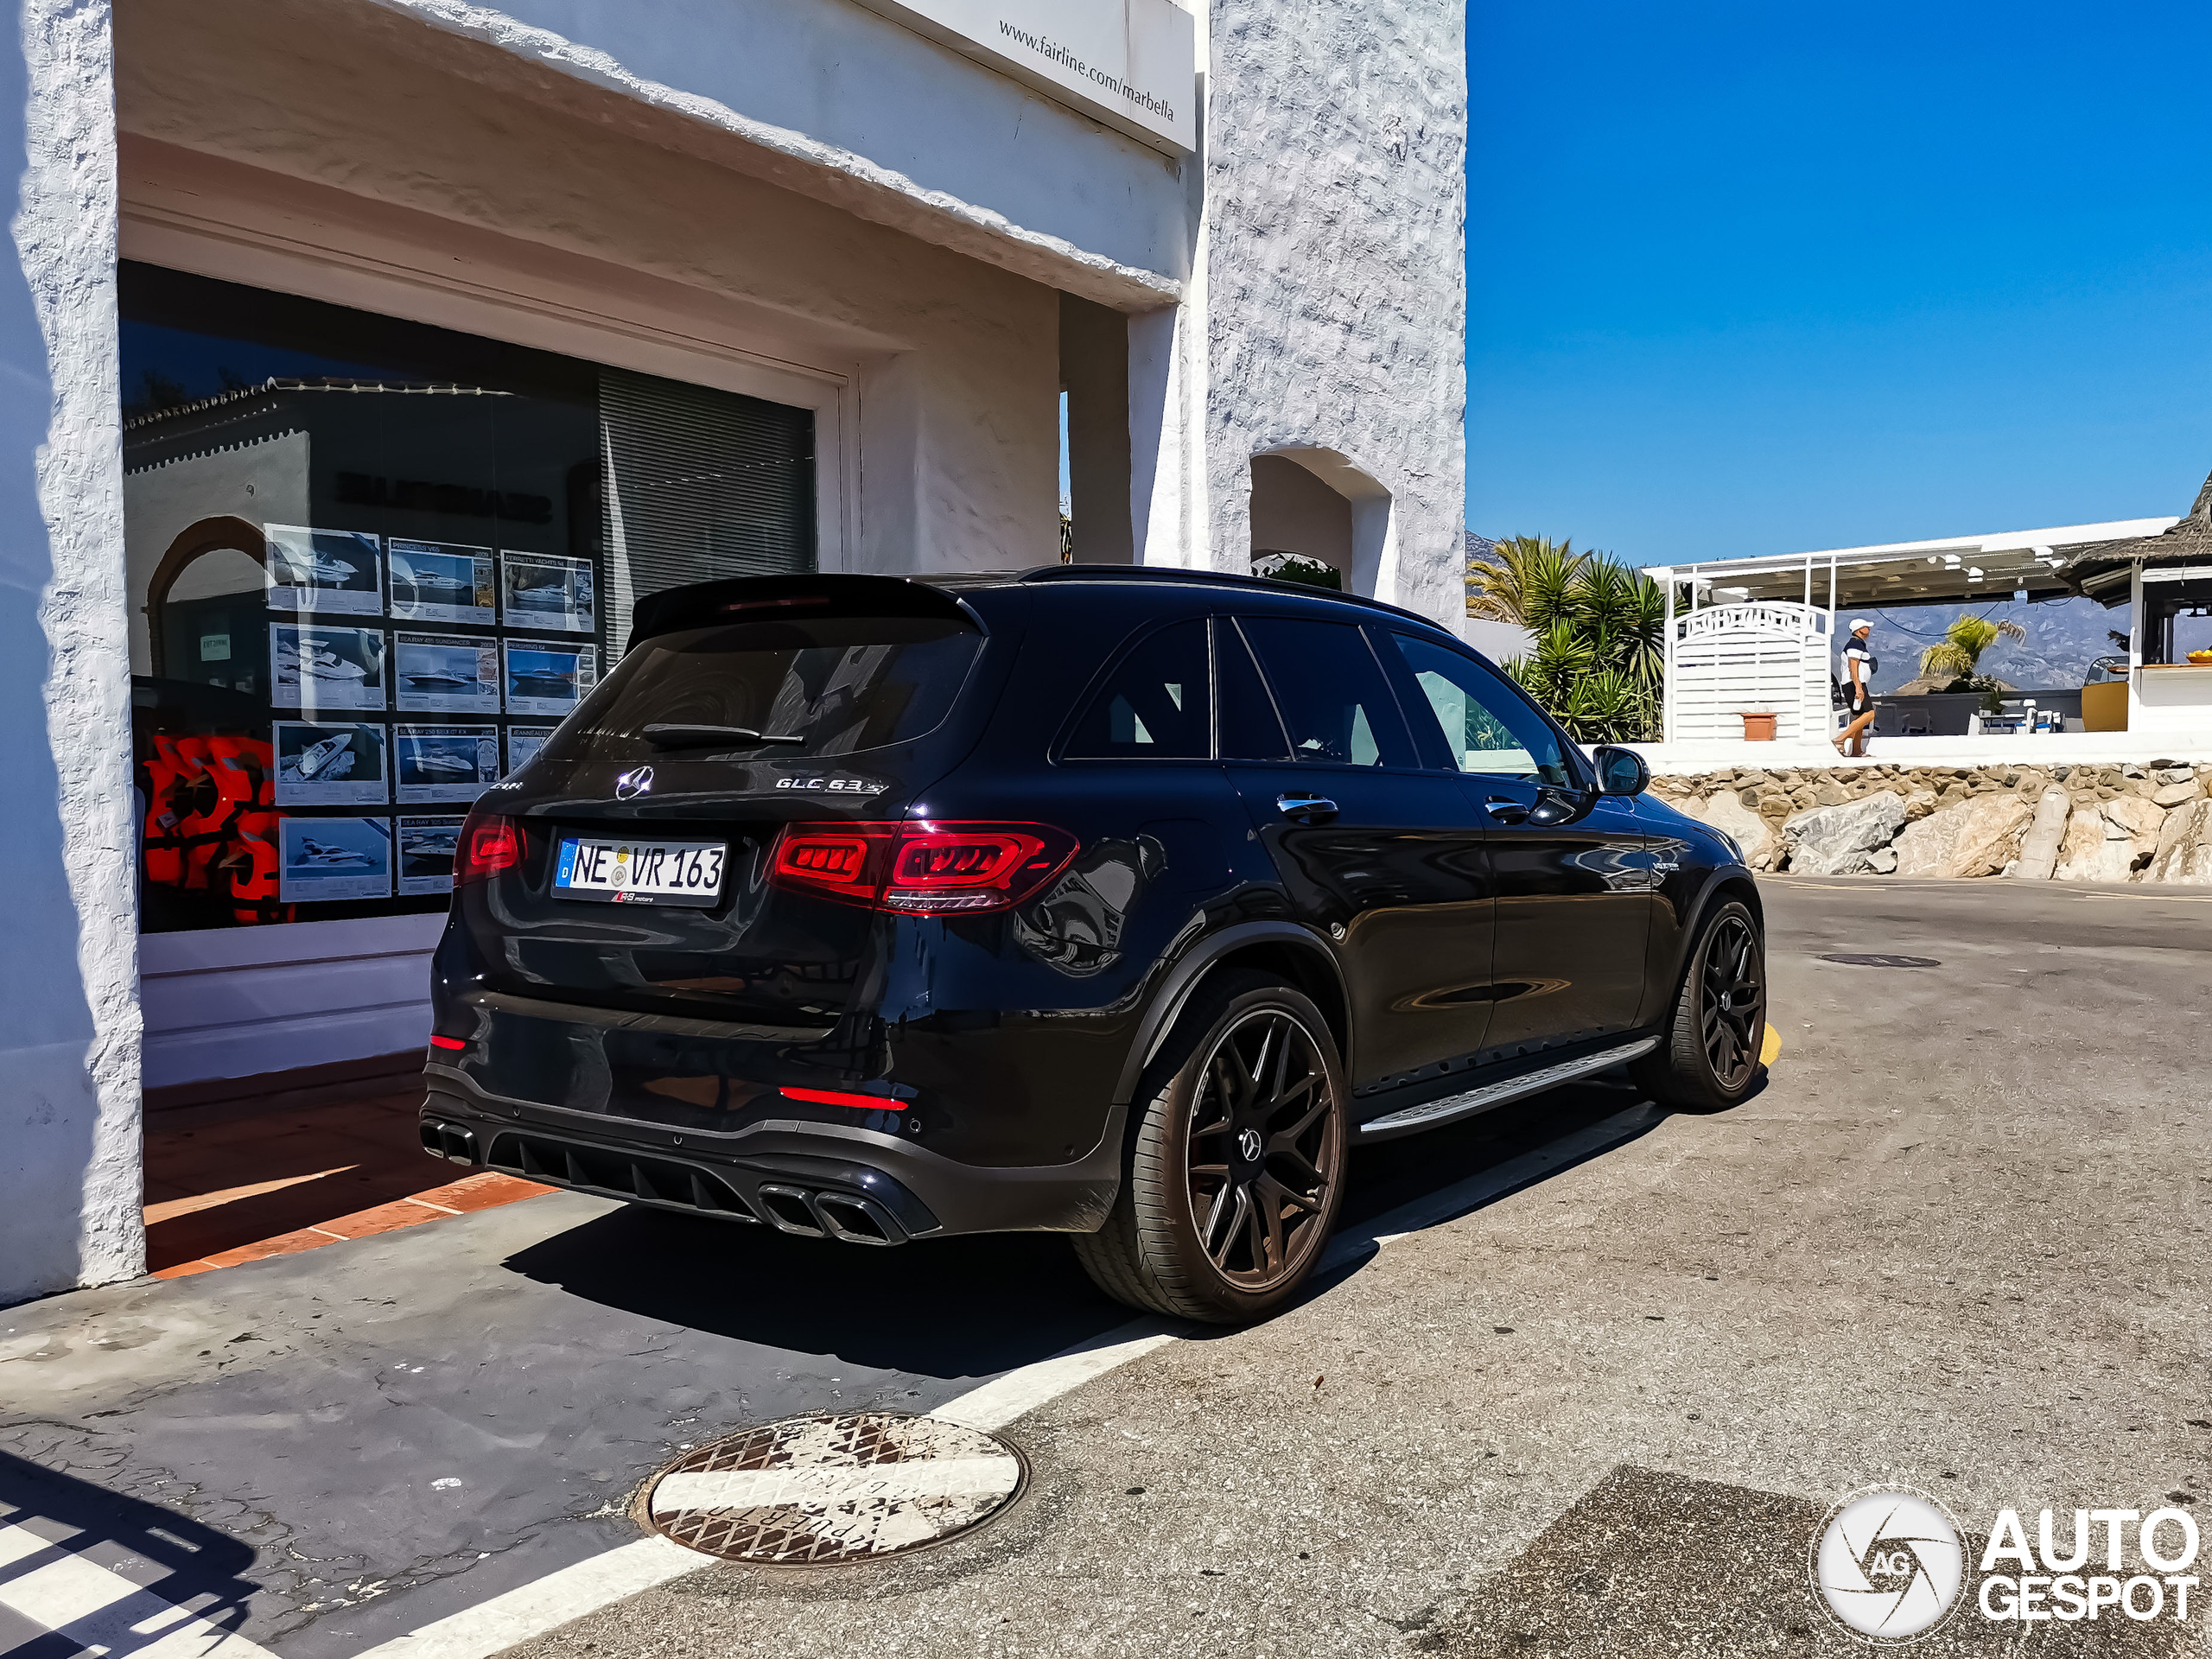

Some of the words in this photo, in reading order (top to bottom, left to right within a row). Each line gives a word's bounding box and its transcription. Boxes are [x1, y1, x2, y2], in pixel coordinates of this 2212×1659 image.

[999, 20, 1174, 123] www.fairline.com/marbella
[392, 542, 426, 551] PRINCESS
[505, 555, 534, 563] FERRETTI
[435, 638, 471, 646] SUNDANCER
[775, 778, 825, 790] GLC
[828, 779, 863, 791] 63
[573, 844, 613, 883] NE
[632, 846, 666, 887] VR
[669, 848, 723, 889] 163
[561, 867, 569, 879] D
